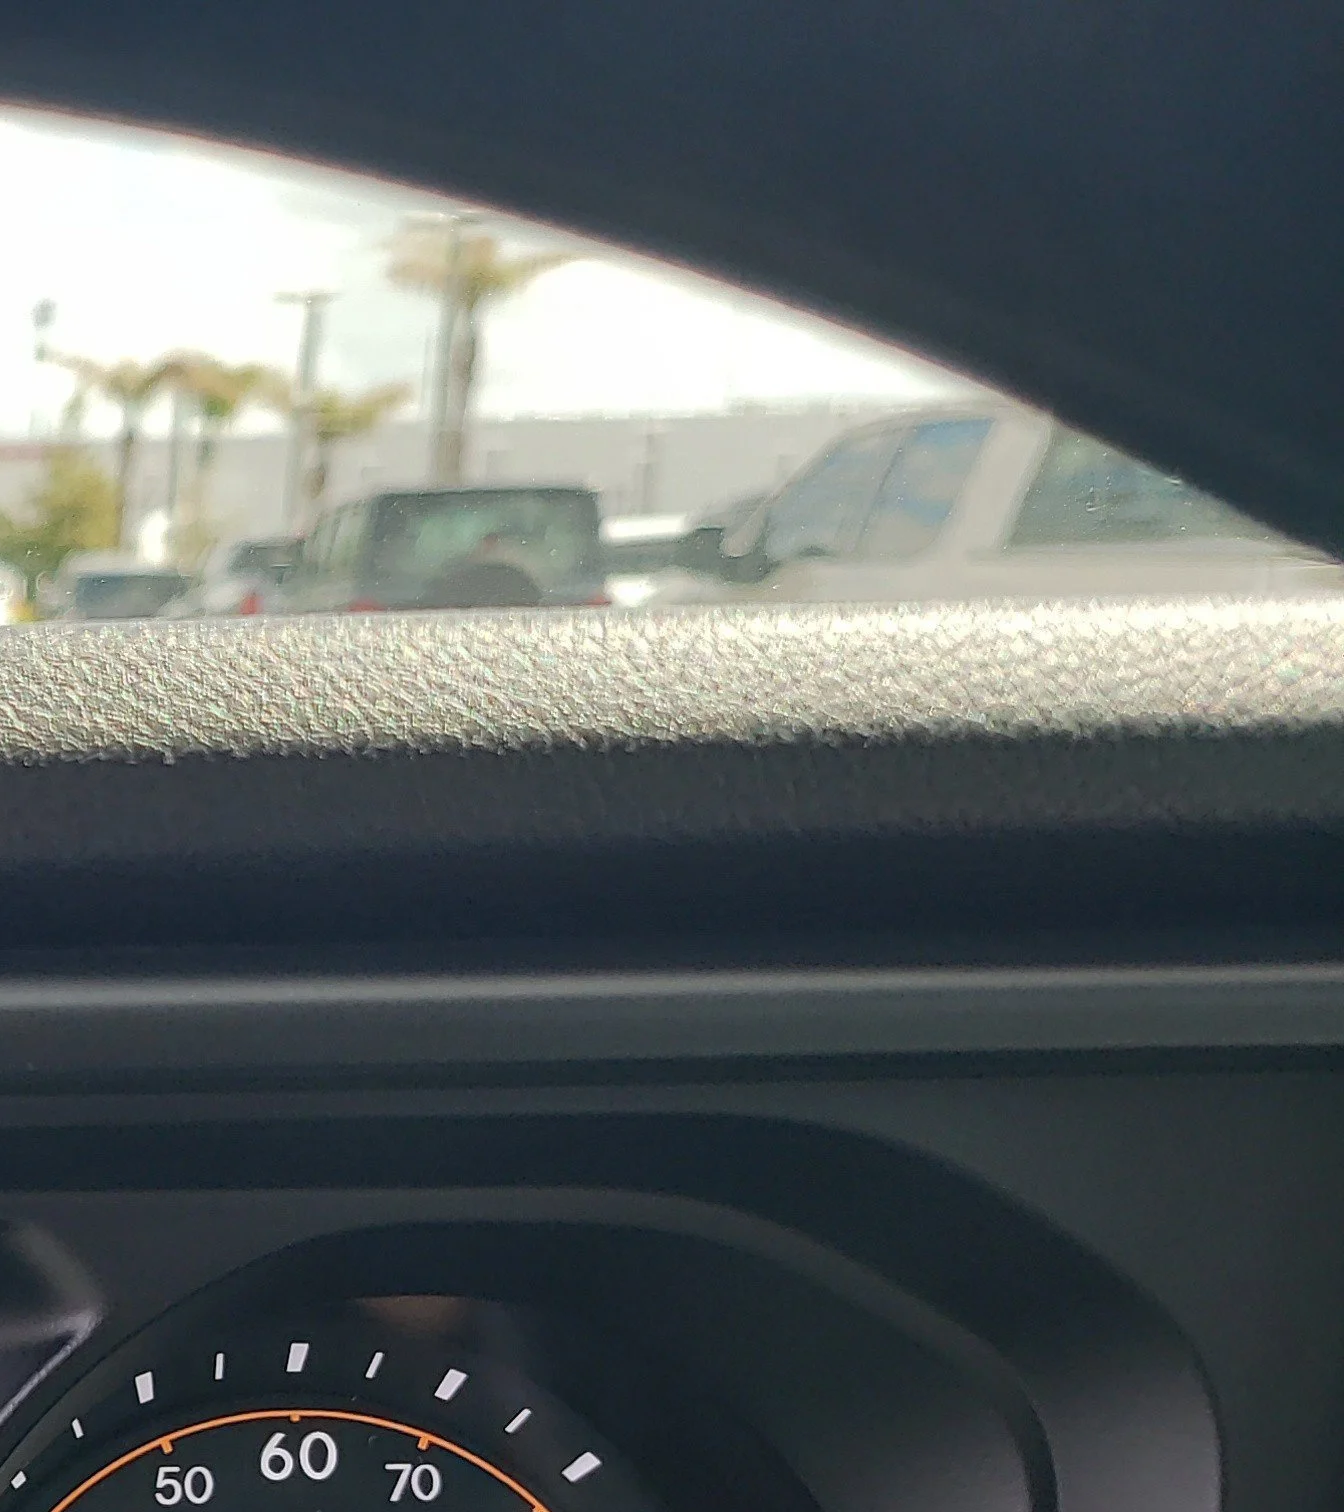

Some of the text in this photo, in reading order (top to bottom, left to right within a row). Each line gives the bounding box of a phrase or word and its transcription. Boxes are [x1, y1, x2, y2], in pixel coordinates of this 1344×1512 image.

[260, 1431, 338, 1482] 60
[154, 1465, 214, 1507] 50
[385, 1462, 442, 1503] 70
